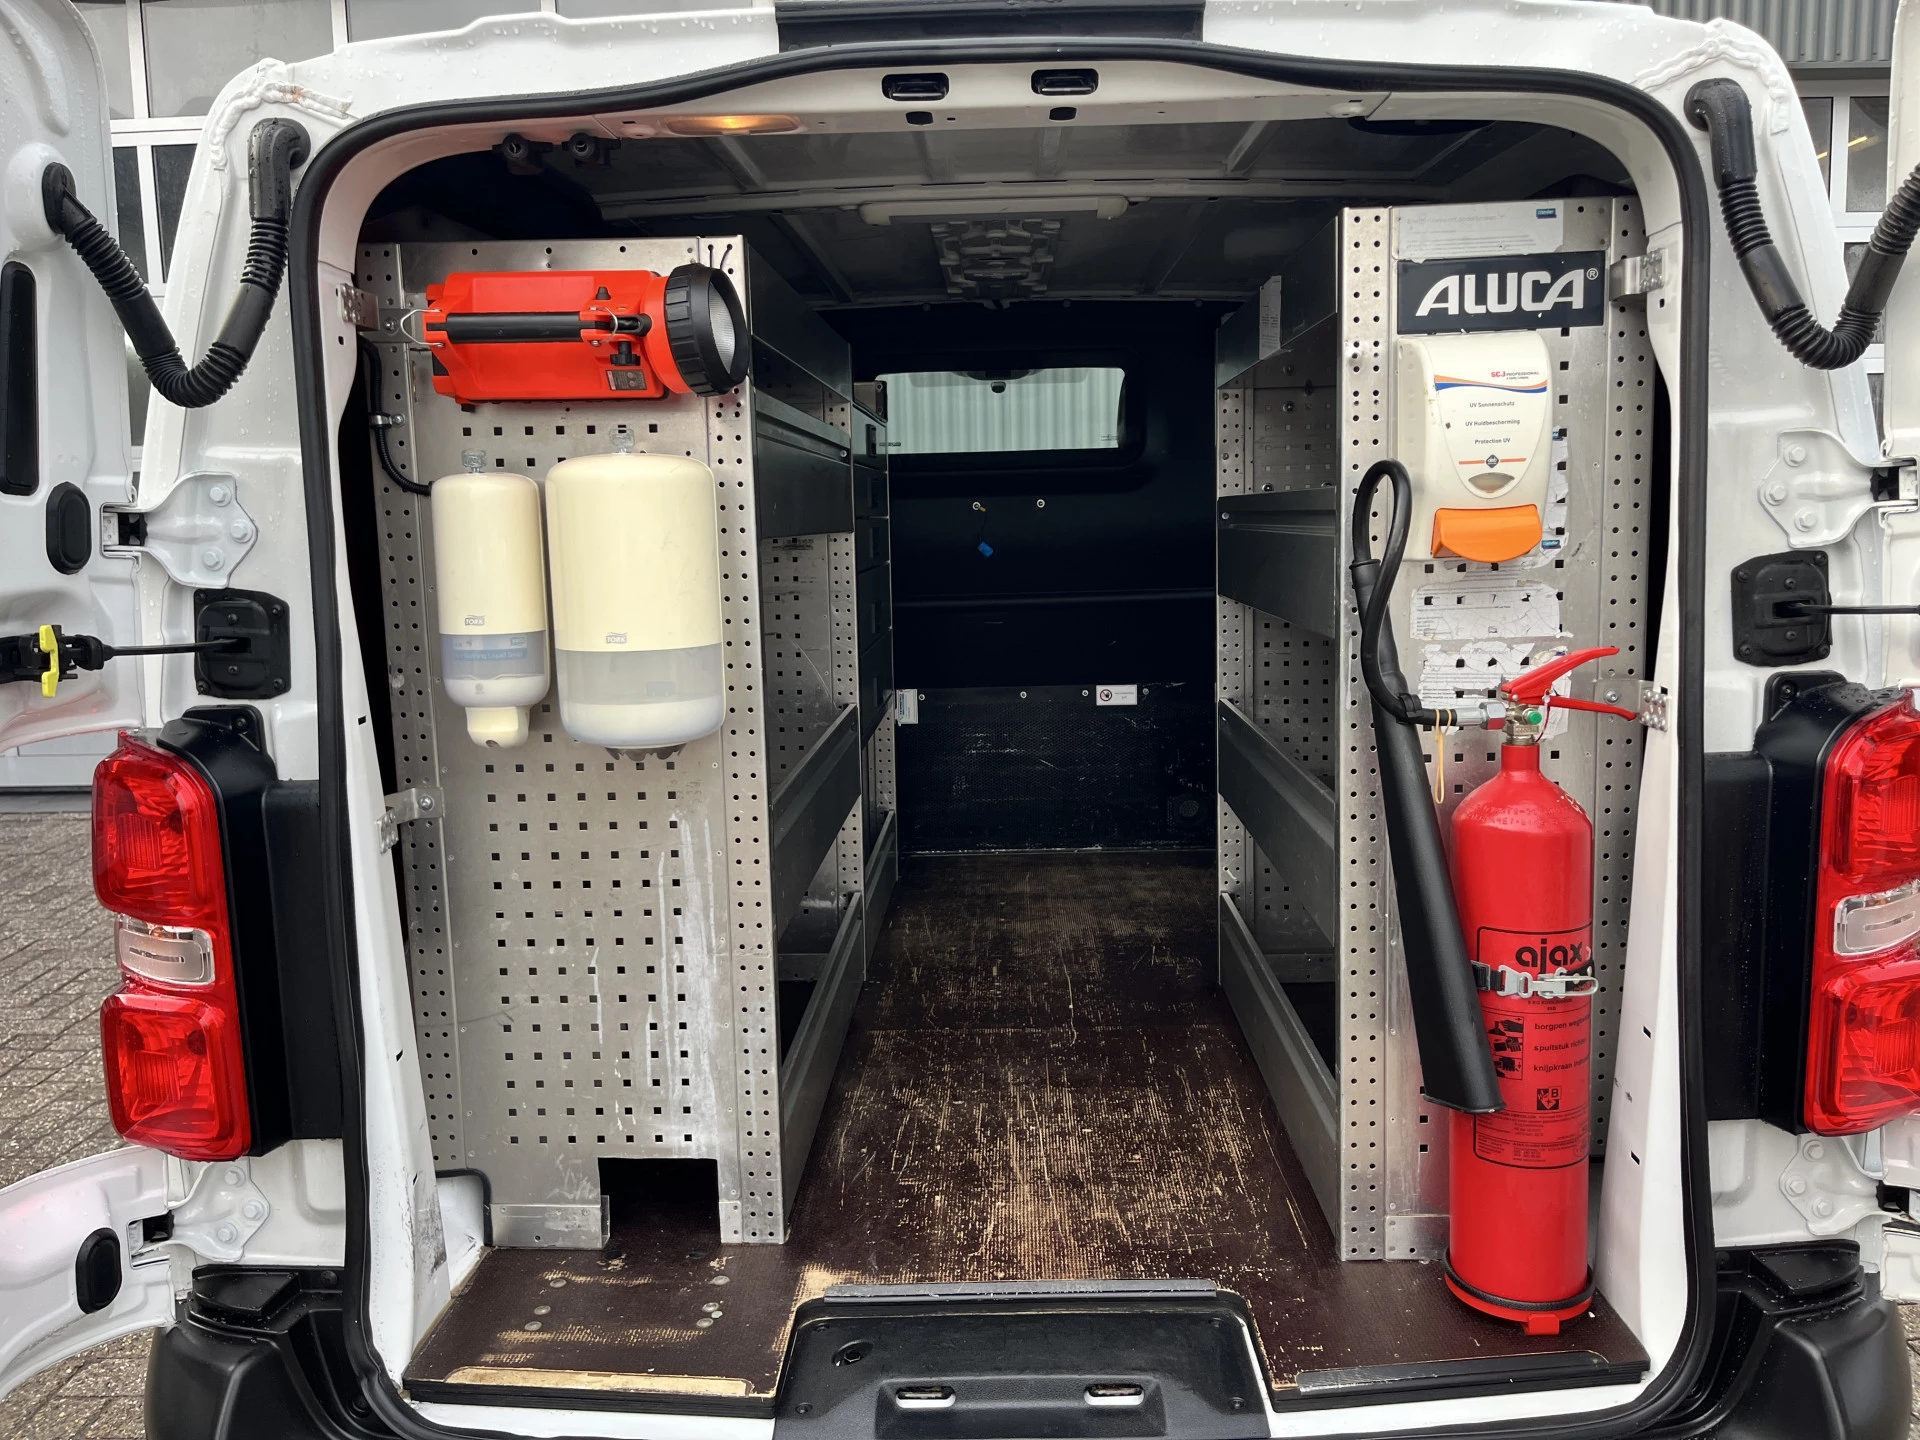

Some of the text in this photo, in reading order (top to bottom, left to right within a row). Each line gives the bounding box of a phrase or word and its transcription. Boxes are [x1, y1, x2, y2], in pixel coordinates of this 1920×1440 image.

[1491, 370, 1506, 378] SCJ
[1474, 419, 1521, 427] Huidbescherming
[465, 618, 484, 626] TORK
[607, 635, 627, 643] TORK
[1515, 938, 1583, 974] ajax
[1534, 1023, 1567, 1032] borgpen
[1534, 1042, 1570, 1053] spuitstuk
[1533, 1063, 1573, 1073] knijpkraan
